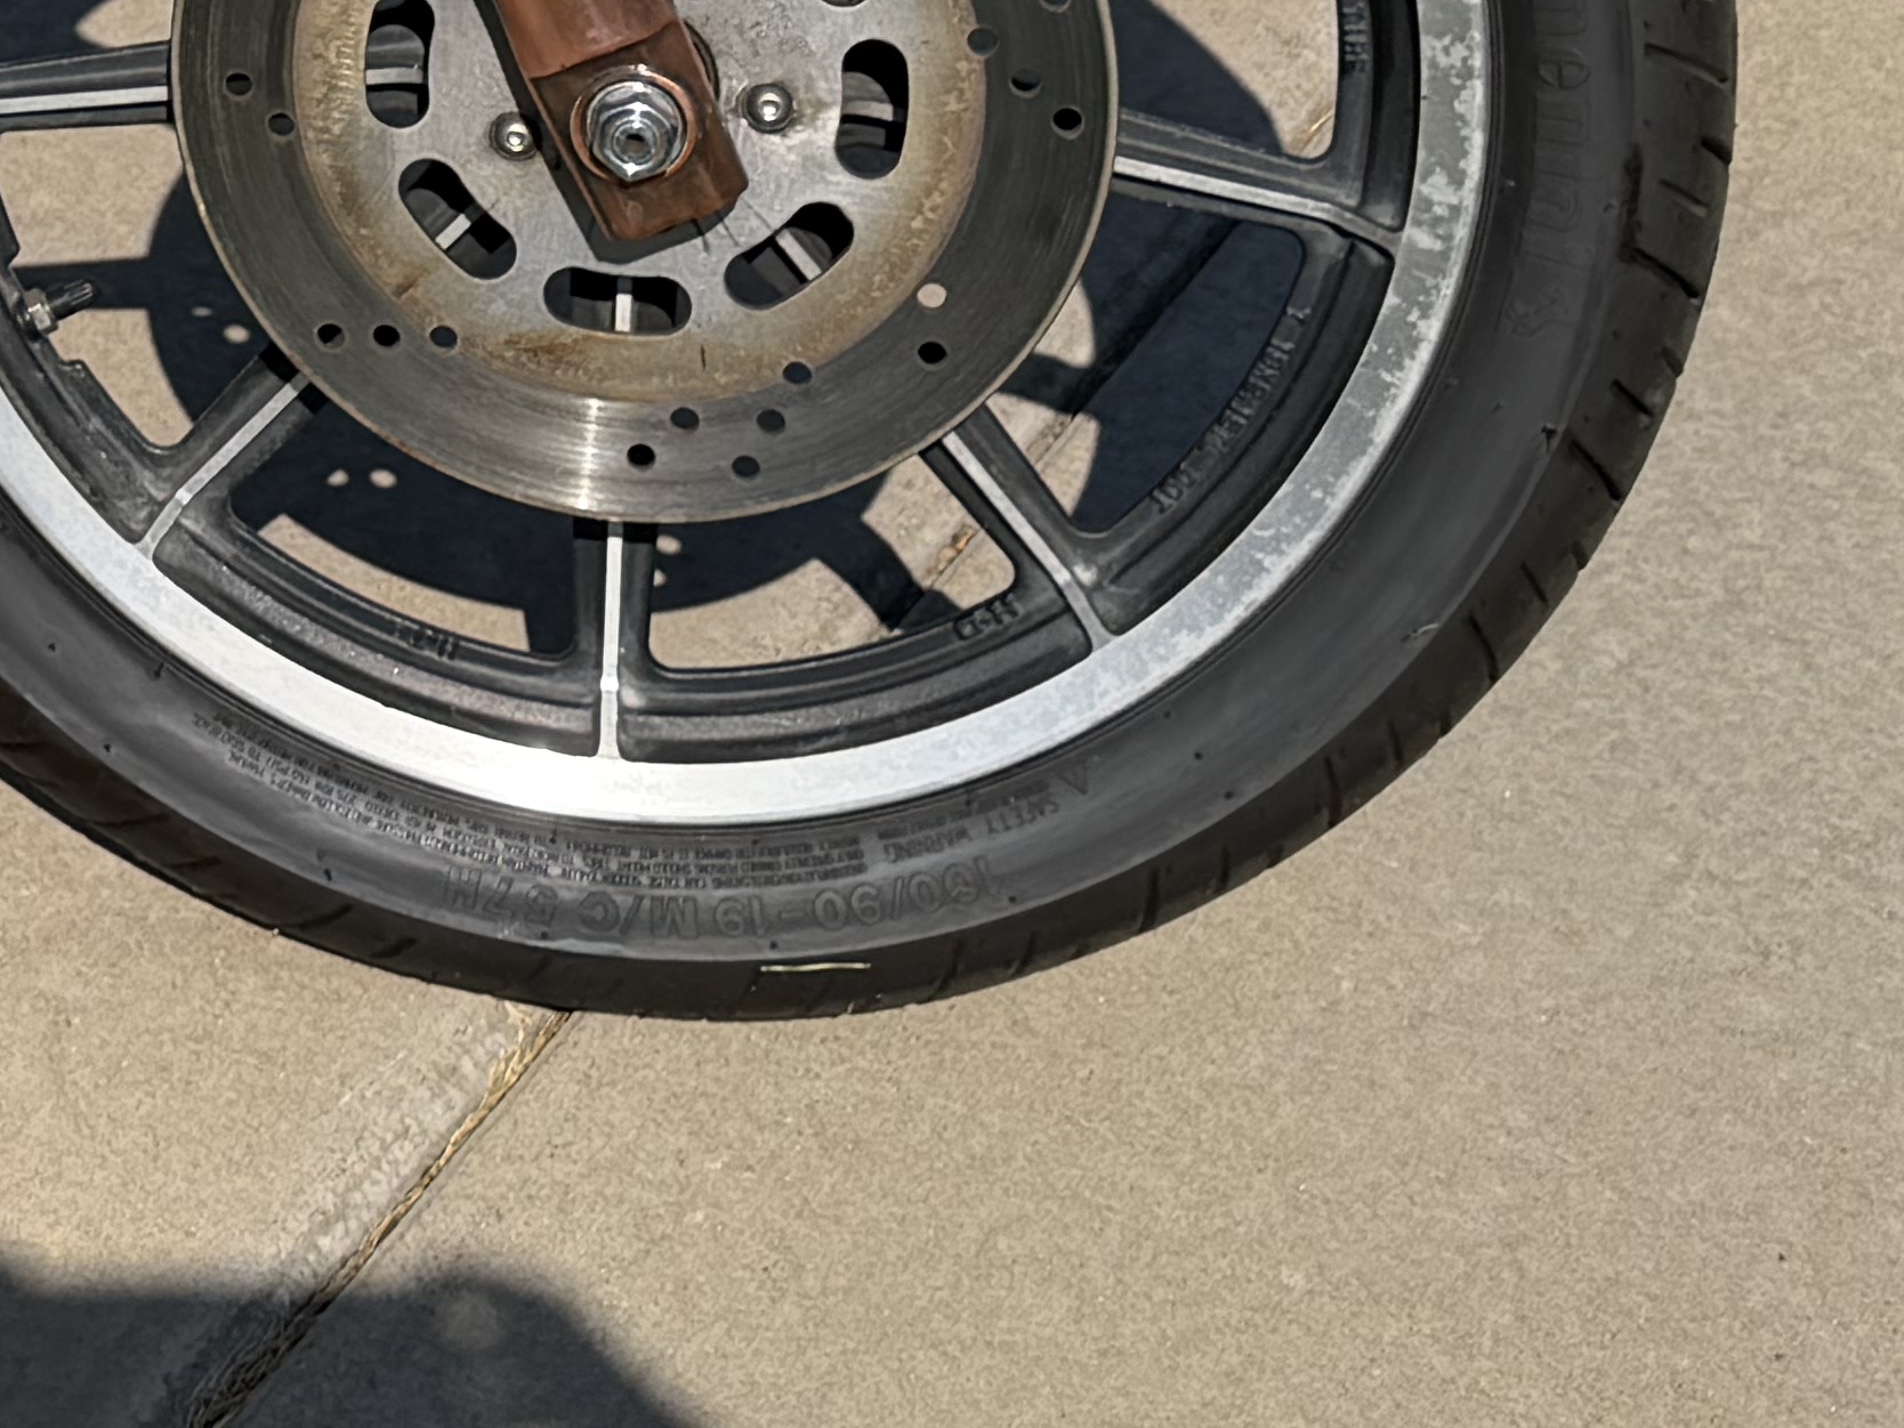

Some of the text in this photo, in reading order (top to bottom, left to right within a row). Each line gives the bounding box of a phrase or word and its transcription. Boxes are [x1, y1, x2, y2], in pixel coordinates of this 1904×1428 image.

[981, 791, 1061, 837] SAFETY
[882, 823, 972, 863] WARNING
[576, 888, 698, 937] M/C
